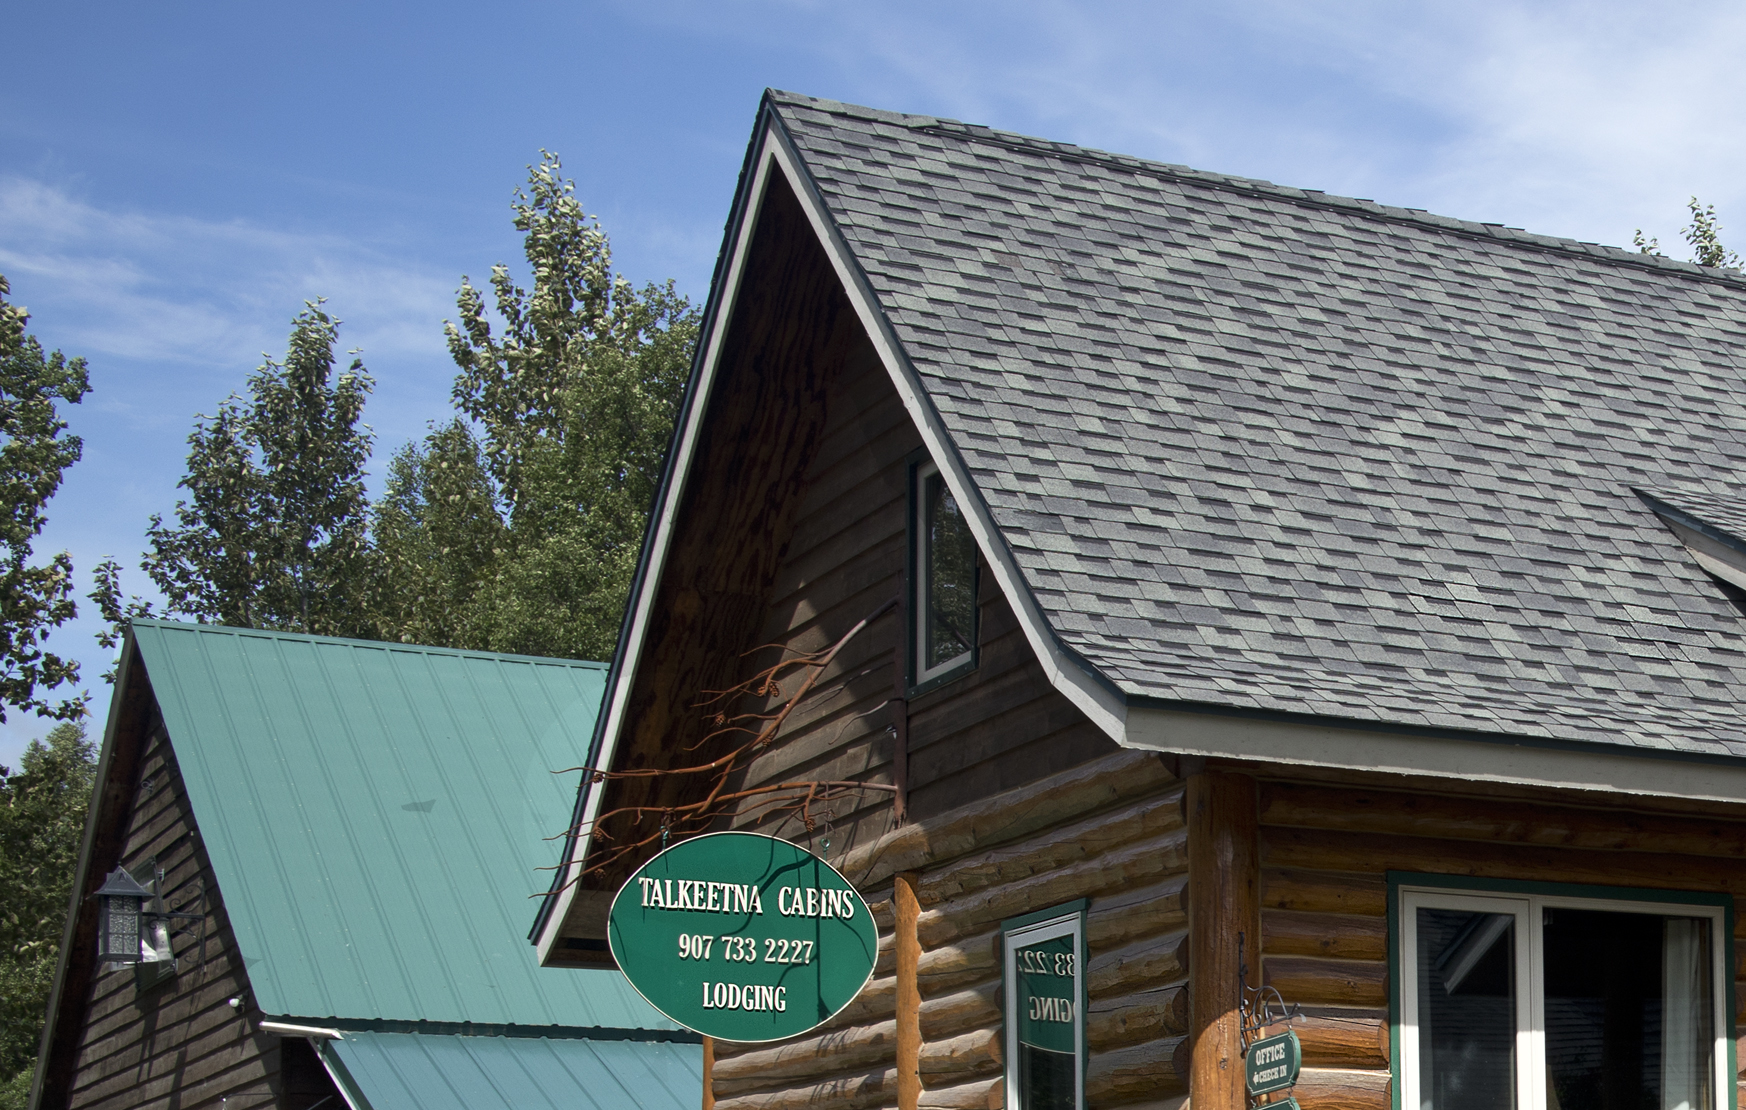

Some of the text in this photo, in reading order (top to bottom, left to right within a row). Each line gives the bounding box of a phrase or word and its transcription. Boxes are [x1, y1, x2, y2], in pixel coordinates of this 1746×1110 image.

[638, 877, 855, 919] TALKEETNA CABINS
[678, 933, 814, 964] 907 733 2227
[702, 982, 786, 1012] LODGING
[1255, 1042, 1286, 1066] OFFICE
[1258, 1064, 1288, 1083] CHECK IN
